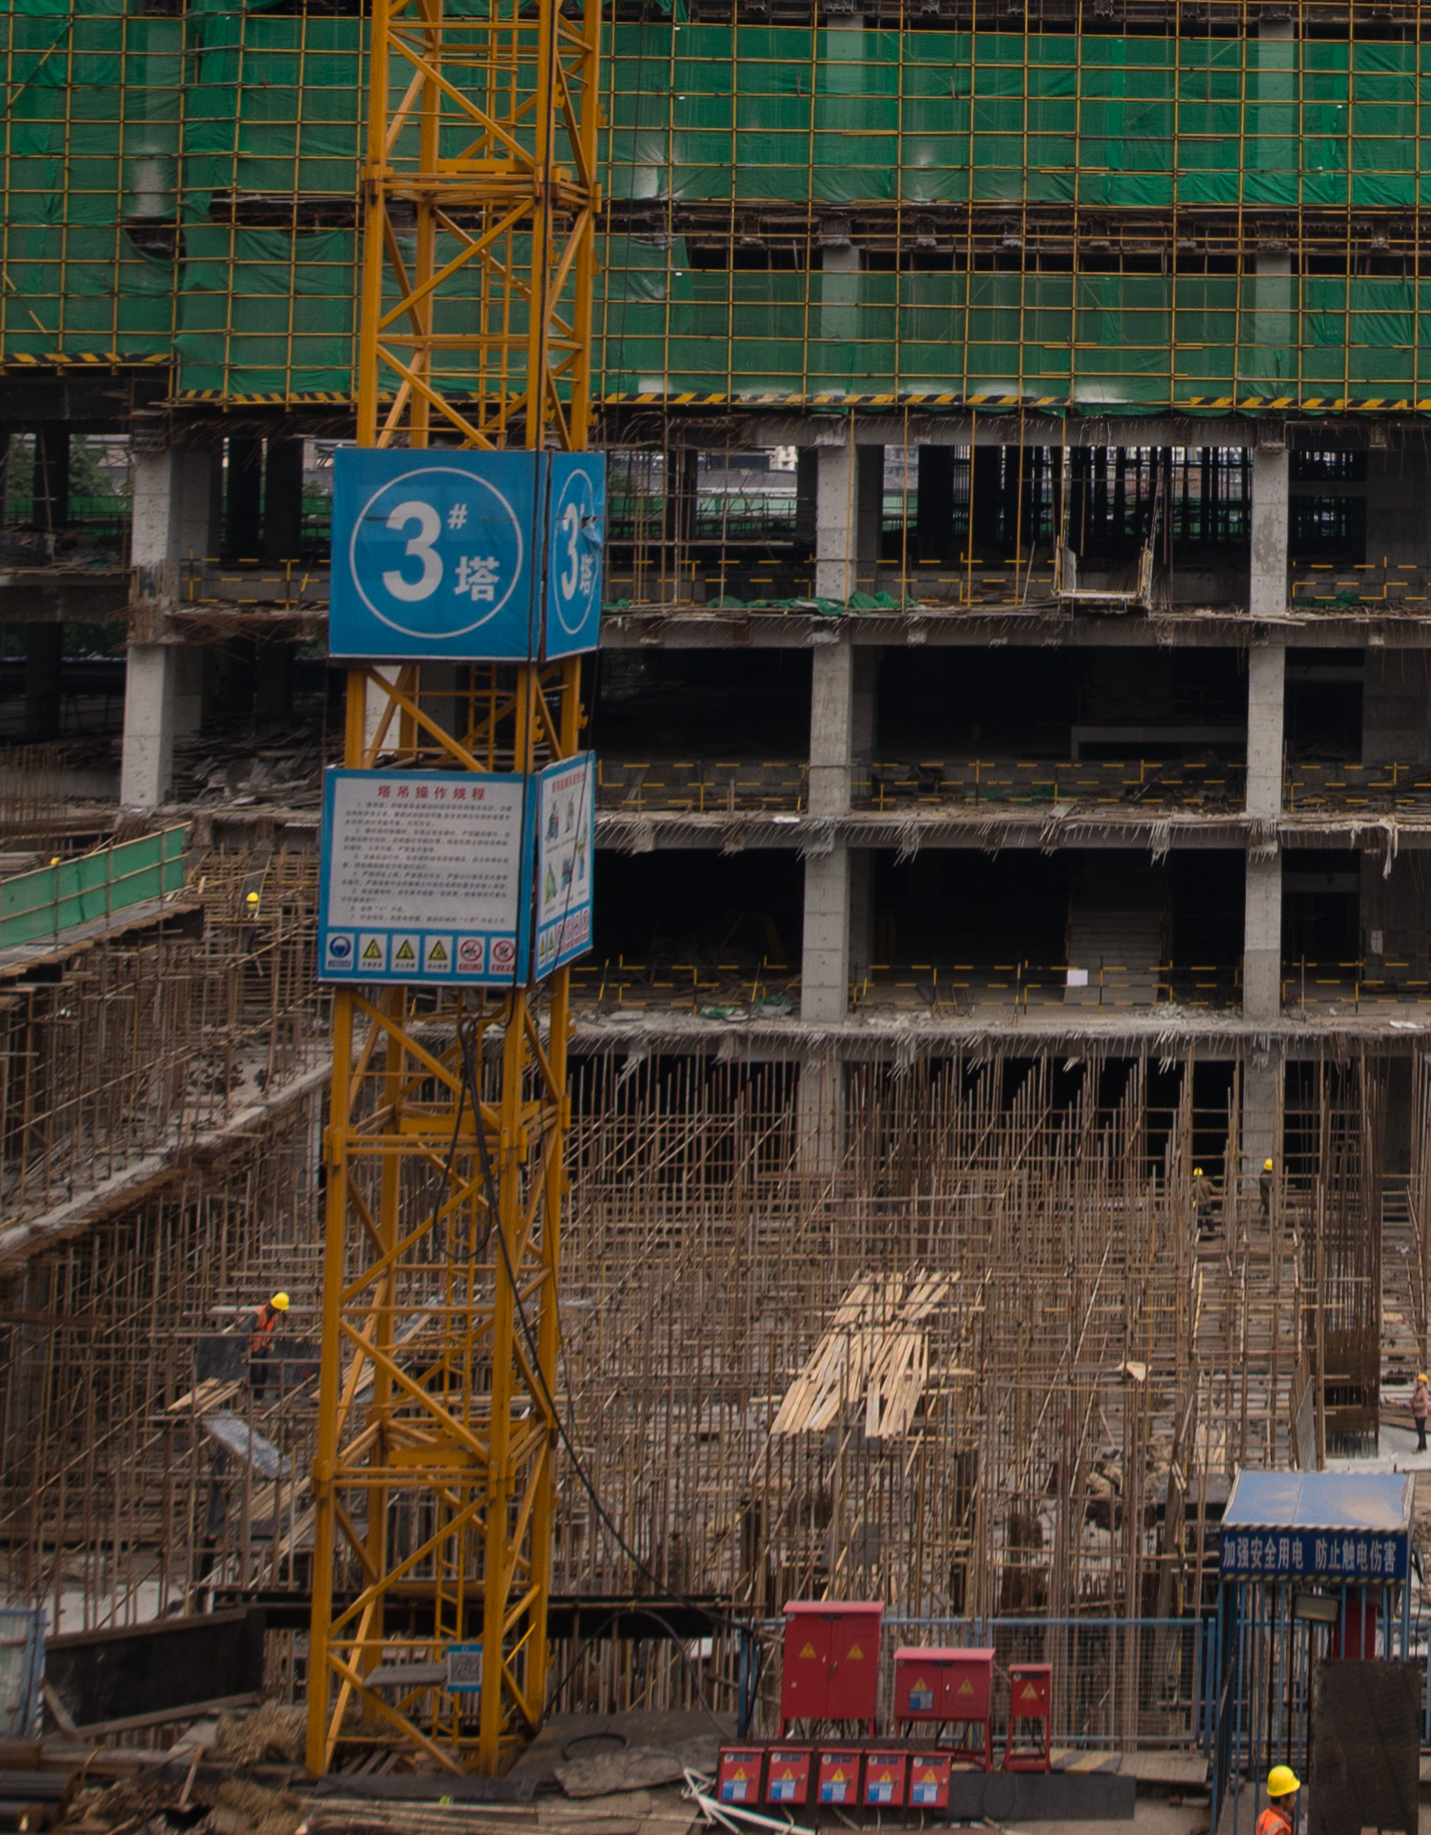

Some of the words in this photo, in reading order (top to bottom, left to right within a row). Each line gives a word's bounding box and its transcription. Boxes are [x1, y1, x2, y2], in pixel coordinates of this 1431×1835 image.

[1223, 1535, 1304, 1570] 加强安全用电
[1315, 1537, 1397, 1574] 防止触电伤害
